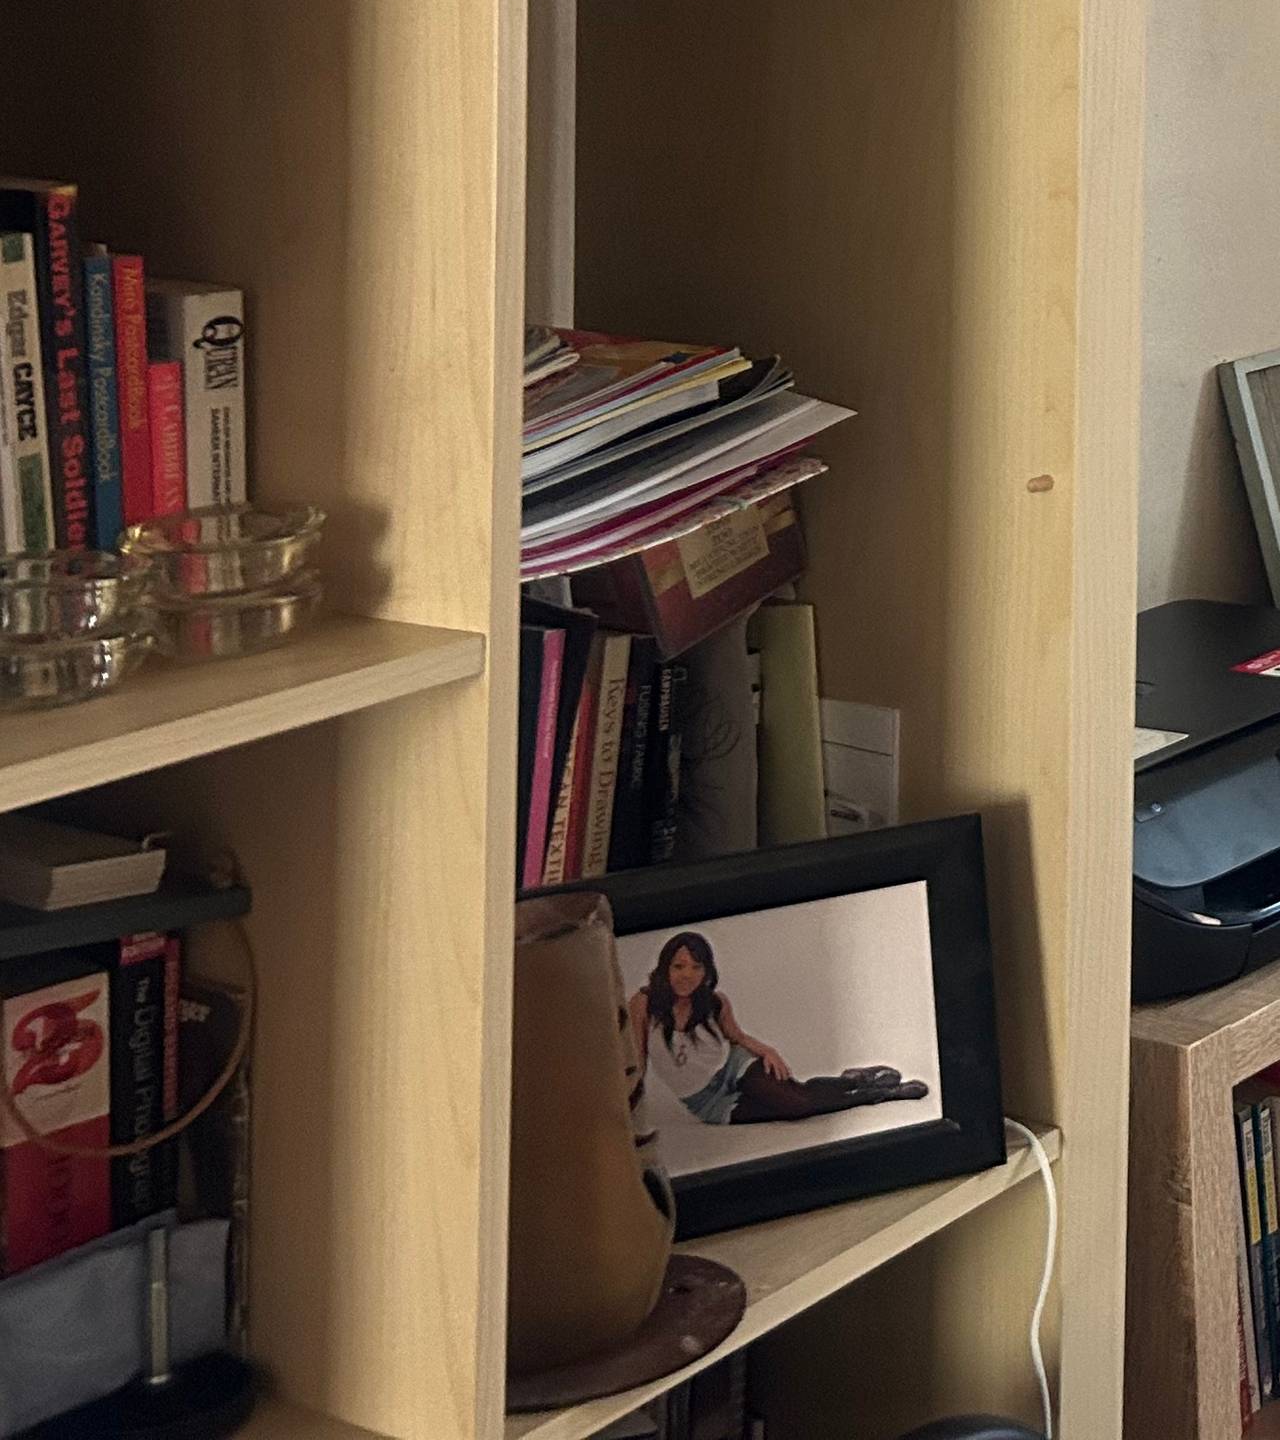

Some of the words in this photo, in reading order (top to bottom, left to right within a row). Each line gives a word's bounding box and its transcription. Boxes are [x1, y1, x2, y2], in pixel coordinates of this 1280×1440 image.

[89, 273, 111, 362] Kandinsky
[12, 361, 38, 442] CAYCE
[56, 347, 81, 426] Last
[602, 676, 626, 735] Keys
[602, 740, 618, 763] to
[548, 817, 568, 884] TEXTIL
[587, 770, 615, 868] Drawing
[129, 1005, 155, 1080] Digital
